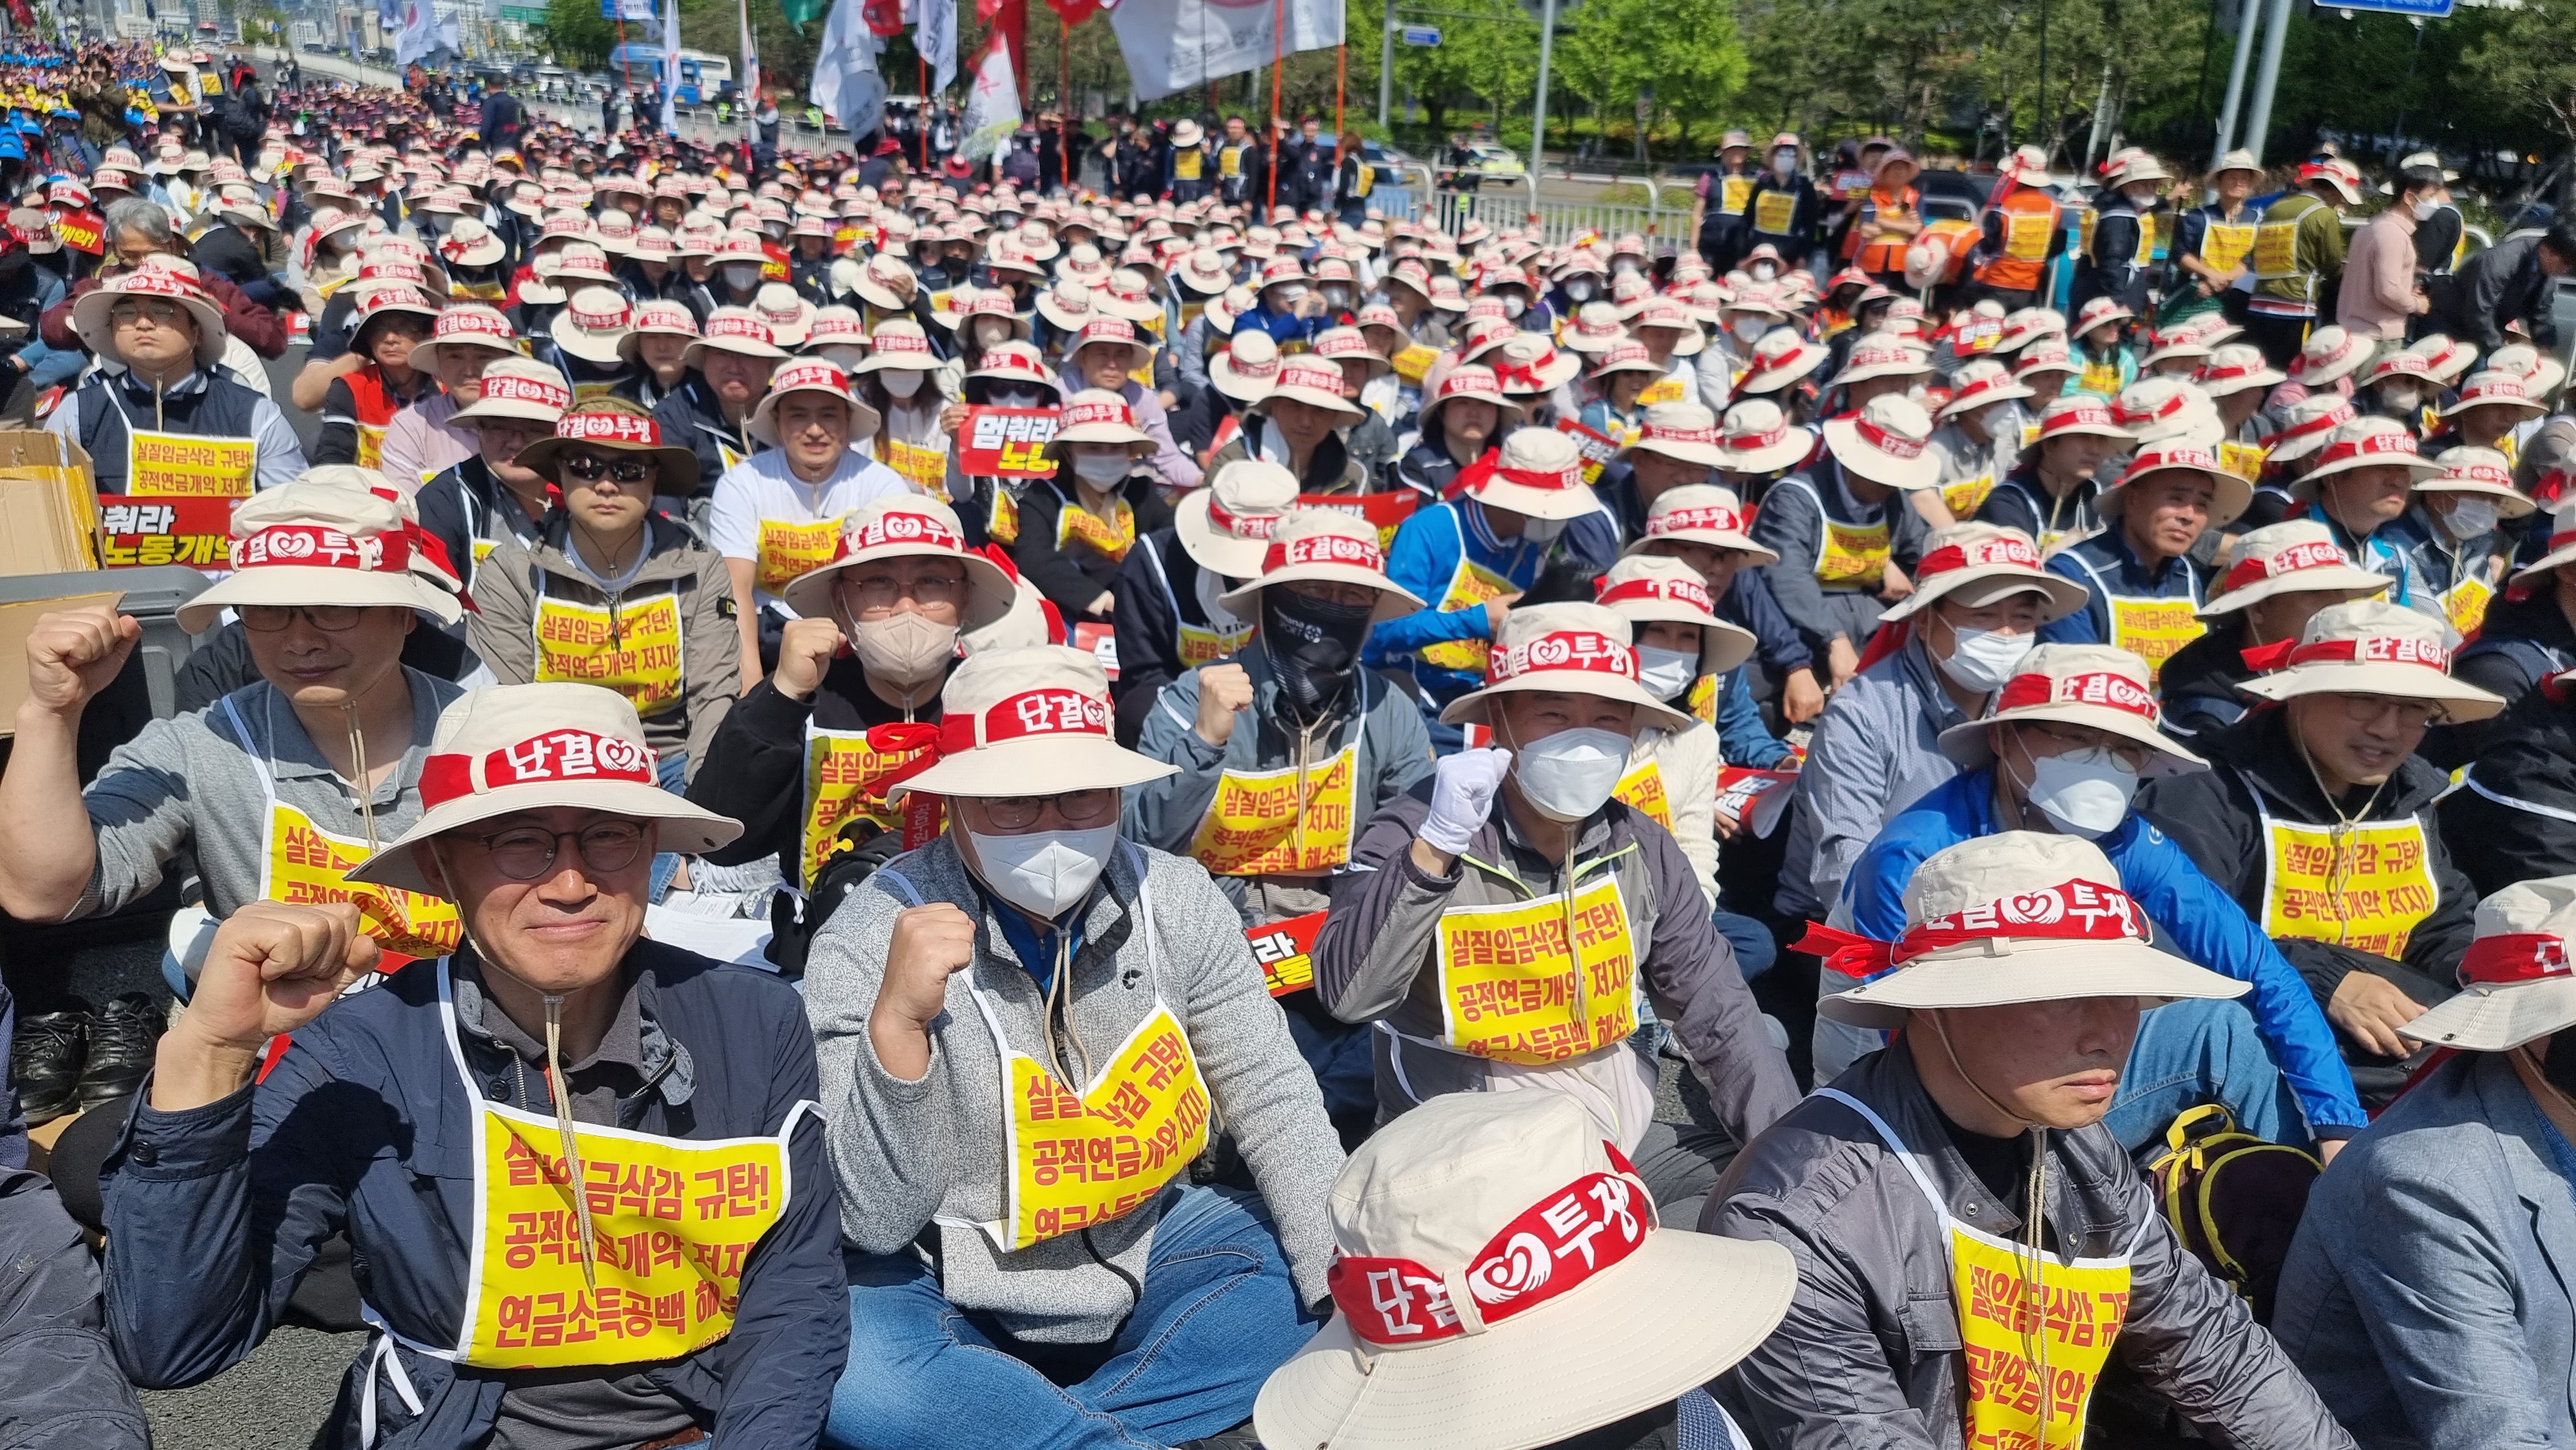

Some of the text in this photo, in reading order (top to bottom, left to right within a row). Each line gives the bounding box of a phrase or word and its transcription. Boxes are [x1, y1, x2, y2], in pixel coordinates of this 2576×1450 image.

[377, 288, 407, 305] 단결
[480, 314, 511, 337] 투쟁
[741, 319, 767, 341] 투쟁
[799, 366, 833, 386] 투쟁
[488, 379, 571, 409] 단결 투쟁
[1095, 404, 1124, 423] 투쟁
[556, 414, 652, 444] 단결 투쟁
[972, 413, 1059, 450] 멈춰라
[2376, 435, 2403, 451] 단결
[137, 442, 252, 469] 실질임금삭감 규탄!
[997, 442, 1060, 472] 노동
[138, 469, 217, 494] 공적연금개악
[100, 504, 175, 535] 춰라
[1690, 507, 1730, 529] 투쟁
[228, 531, 270, 568] 결
[2275, 546, 2312, 575] 단결
[638, 608, 673, 637] 규탄!
[642, 644, 676, 671] 저지!
[1571, 635, 1627, 672] 투쟁
[2366, 636, 2418, 662] 단결
[1016, 694, 1084, 732] 단결
[1306, 804, 1346, 833] 저지!
[2384, 841, 2420, 875] 규탄!
[2069, 883, 2139, 936] 투쟁
[2386, 884, 2430, 918] 저지!
[1248, 932, 1298, 964] 라
[1451, 901, 1624, 968] 실질임금삭감 규탄!
[1590, 954, 1629, 999] 저지!
[1131, 1031, 1187, 1092] 규탄!
[1032, 1085, 1207, 1186] 공적연금개악 저지!
[694, 1161, 769, 1221] 규탄!
[1540, 1176, 1640, 1272] 투쟁
[495, 1286, 686, 1349] 연금소득공백
